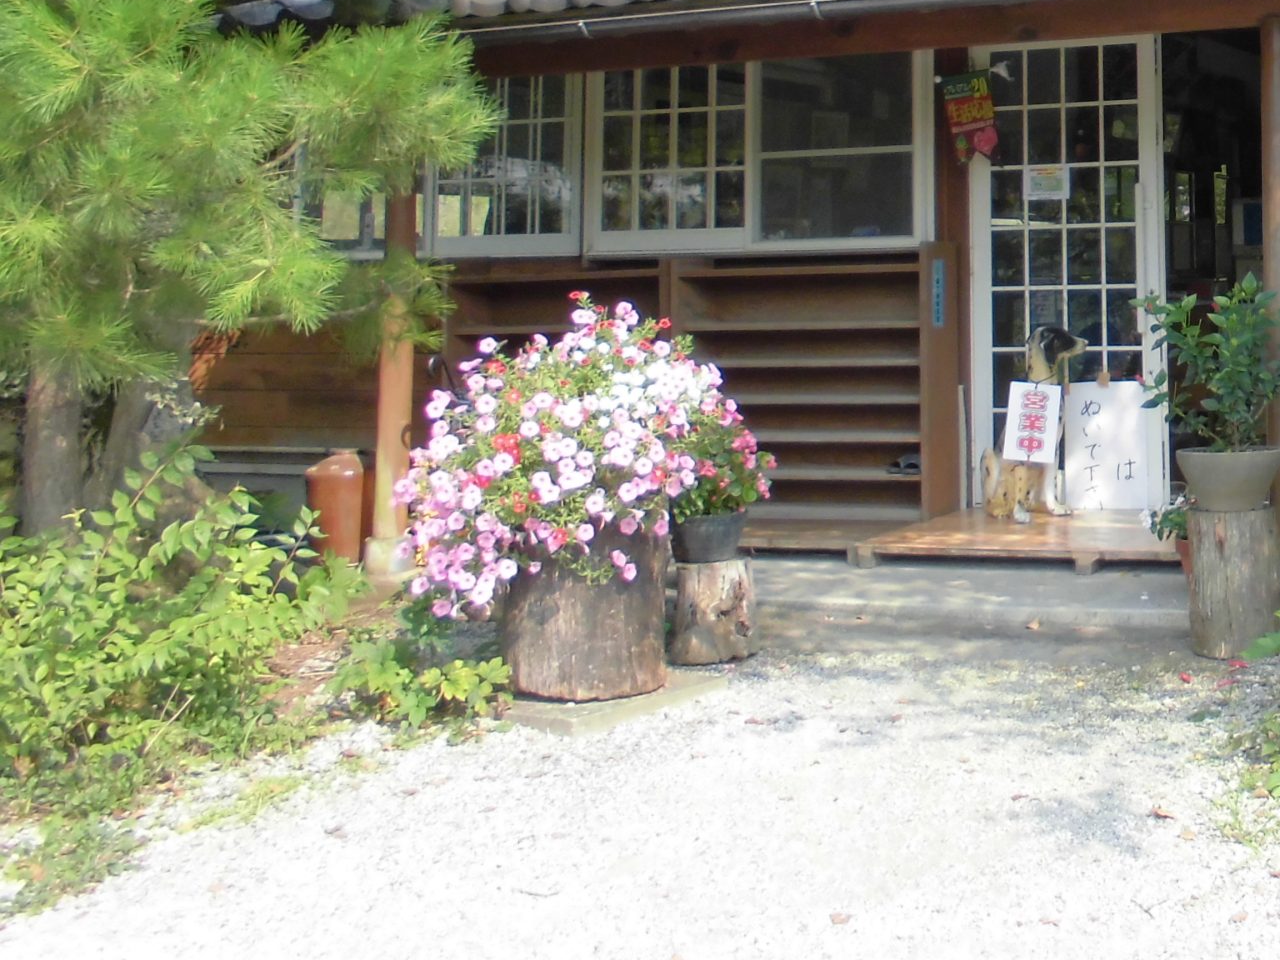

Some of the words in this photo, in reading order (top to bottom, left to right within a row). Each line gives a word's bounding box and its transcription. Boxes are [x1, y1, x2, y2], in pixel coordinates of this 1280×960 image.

[1016, 390, 1049, 455] 営業中
[1117, 458, 1136, 480] は
